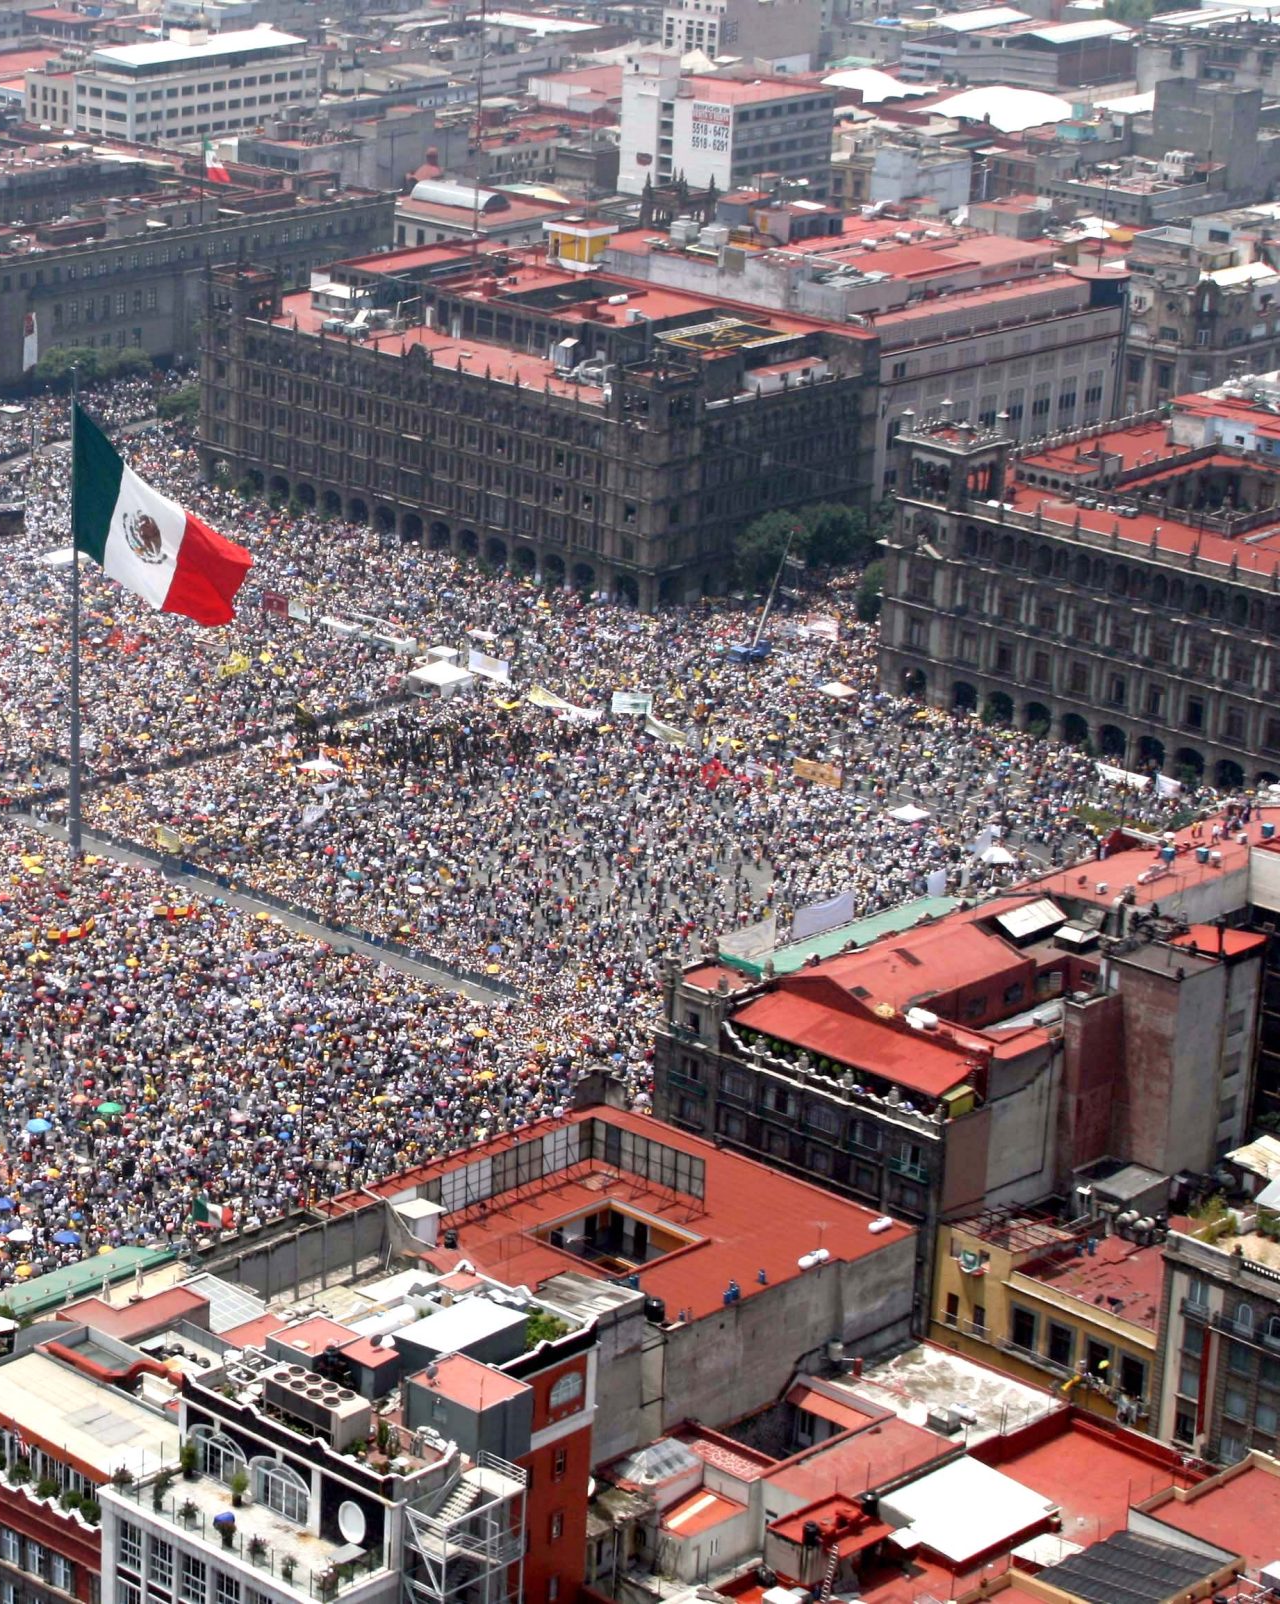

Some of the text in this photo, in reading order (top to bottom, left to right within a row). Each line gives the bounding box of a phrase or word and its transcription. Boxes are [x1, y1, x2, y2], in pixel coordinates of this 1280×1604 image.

[692, 122, 708, 136] 5518
[713, 125, 729, 139] 6472
[691, 136, 708, 149] 5518
